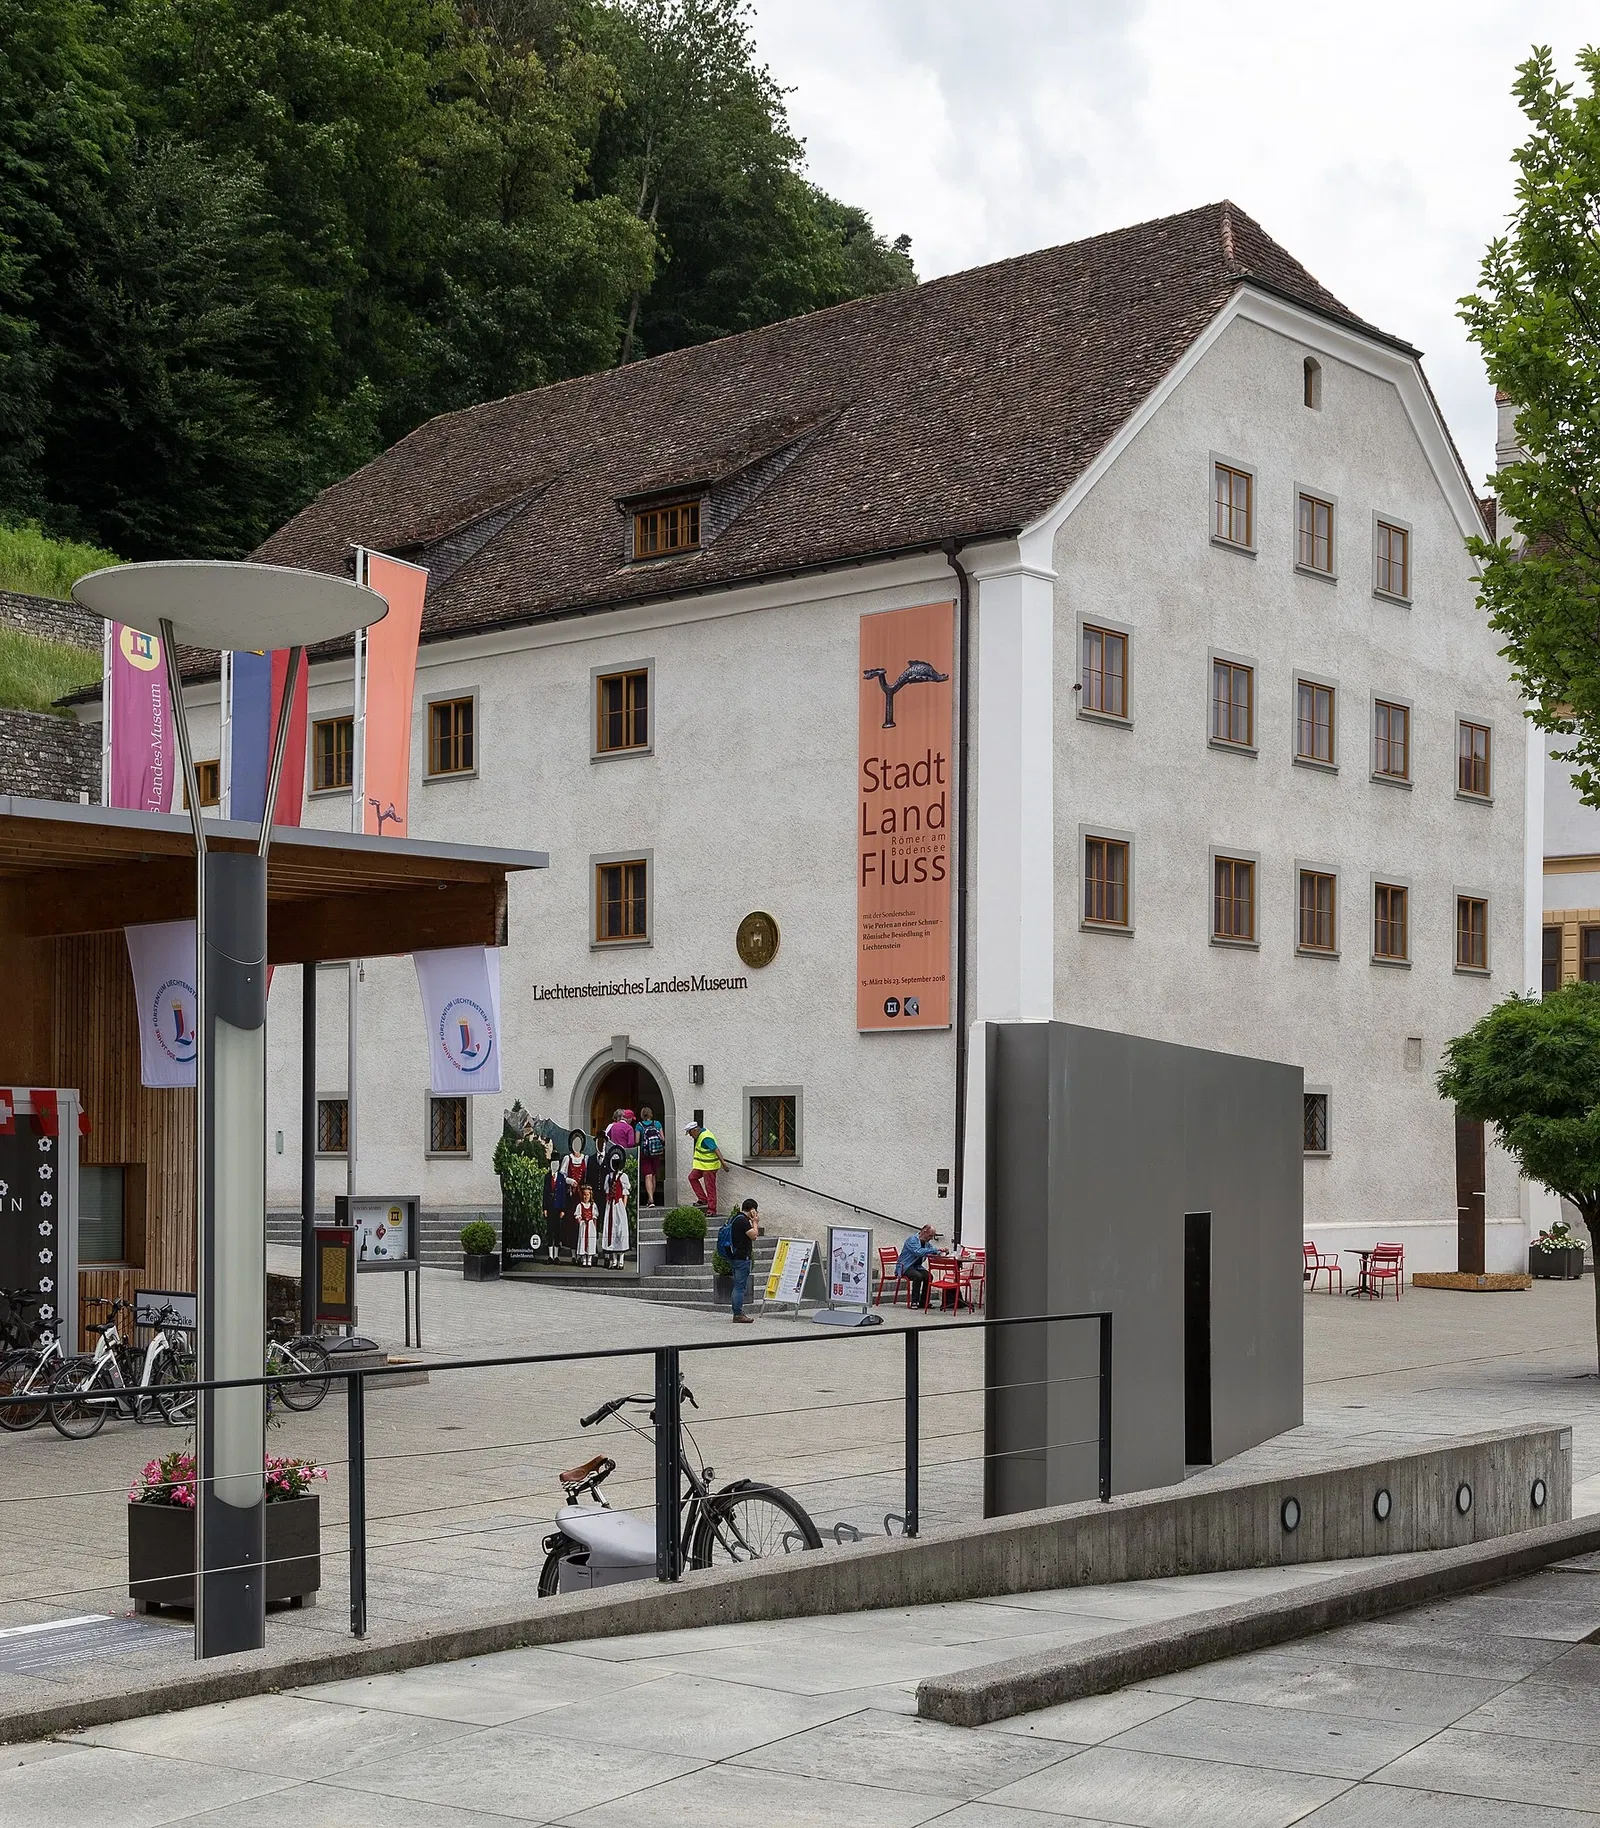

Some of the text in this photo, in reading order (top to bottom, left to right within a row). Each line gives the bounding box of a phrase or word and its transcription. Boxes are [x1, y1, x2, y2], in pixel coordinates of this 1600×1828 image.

[862, 748, 946, 793] Stadt
[862, 791, 946, 836] Land
[891, 833, 946, 846] Römer am
[891, 844, 946, 857] Bodensee
[862, 849, 946, 888] Fluss
[872, 911, 881, 919] der
[882, 910, 916, 918] Sonderschau
[862, 922, 874, 930] Wie
[874, 921, 894, 929] Perlen
[902, 920, 917, 928] einer
[917, 918, 939, 926] Schnur
[862, 931, 891, 940] Römische
[891, 930, 924, 939] Besiedlung
[862, 942, 901, 951] Liechtenstein
[883, 977, 892, 985] bis
[901, 976, 931, 985] September
[532, 978, 644, 1001] Liechtensteinisches
